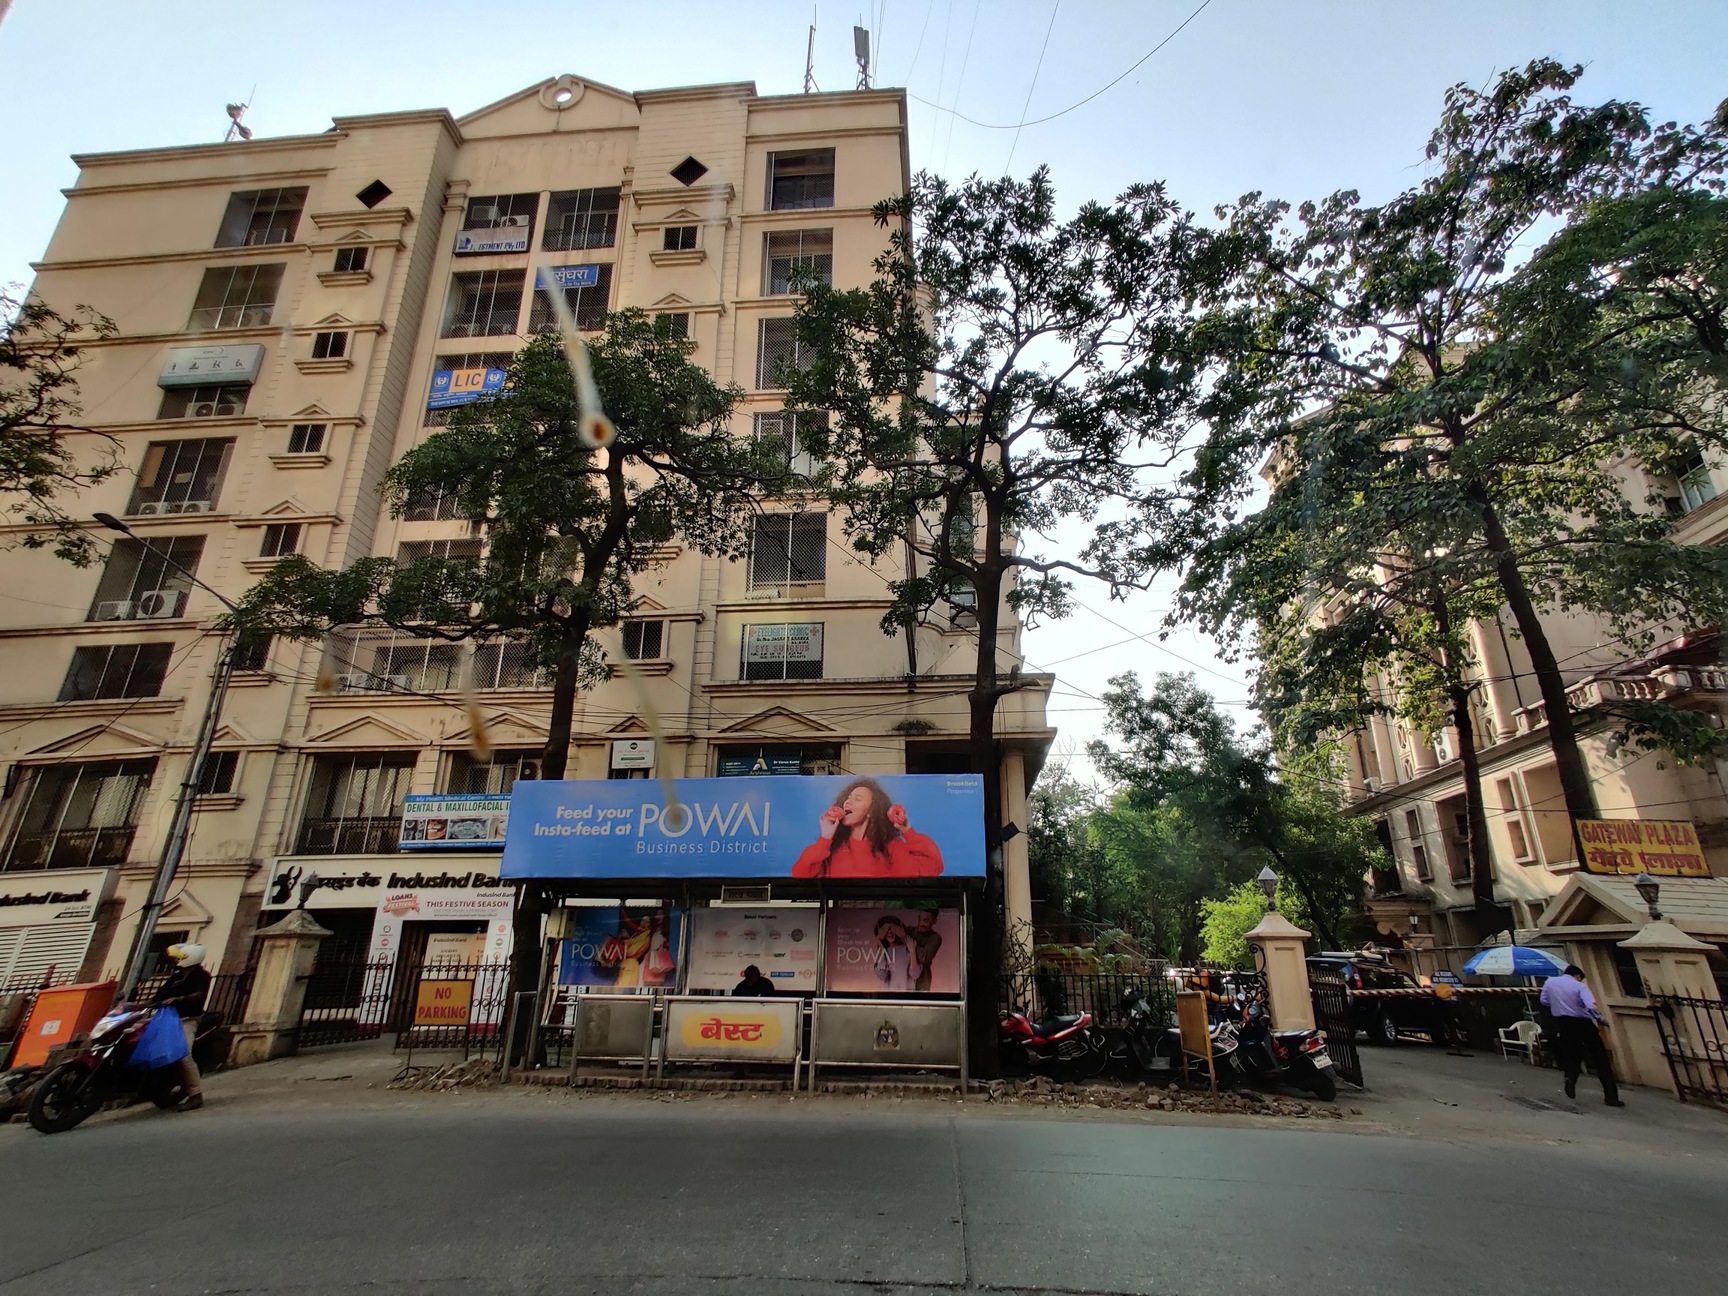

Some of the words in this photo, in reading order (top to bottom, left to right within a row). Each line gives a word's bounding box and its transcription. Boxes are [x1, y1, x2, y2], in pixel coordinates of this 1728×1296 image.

[455, 372, 482, 387] LIC
[755, 644, 769, 653] EYE
[406, 803, 435, 813] DENTAL
[436, 803, 442, 812] &
[445, 801, 503, 812] MAXILLOFACIAL
[556, 805, 593, 820] Feed
[597, 808, 633, 822] your
[638, 801, 770, 838] POWAI
[534, 822, 611, 836] Insta-feed
[615, 823, 632, 836] at
[1581, 822, 1642, 845] GATEWAY
[1645, 823, 1695, 846] PLAZA
[636, 840, 704, 854] Business
[710, 839, 768, 854] District
[387, 872, 471, 889] IndusInd
[48, 889, 91, 903] Bank
[391, 893, 413, 901] LOANS
[388, 900, 414, 909] FESTIVAL
[571, 943, 627, 960] POWAI
[837, 946, 896, 964] POWAI
[434, 987, 452, 1000] NO
[418, 1005, 466, 1019] PARKING
[700, 1017, 765, 1042] बेस्ट
